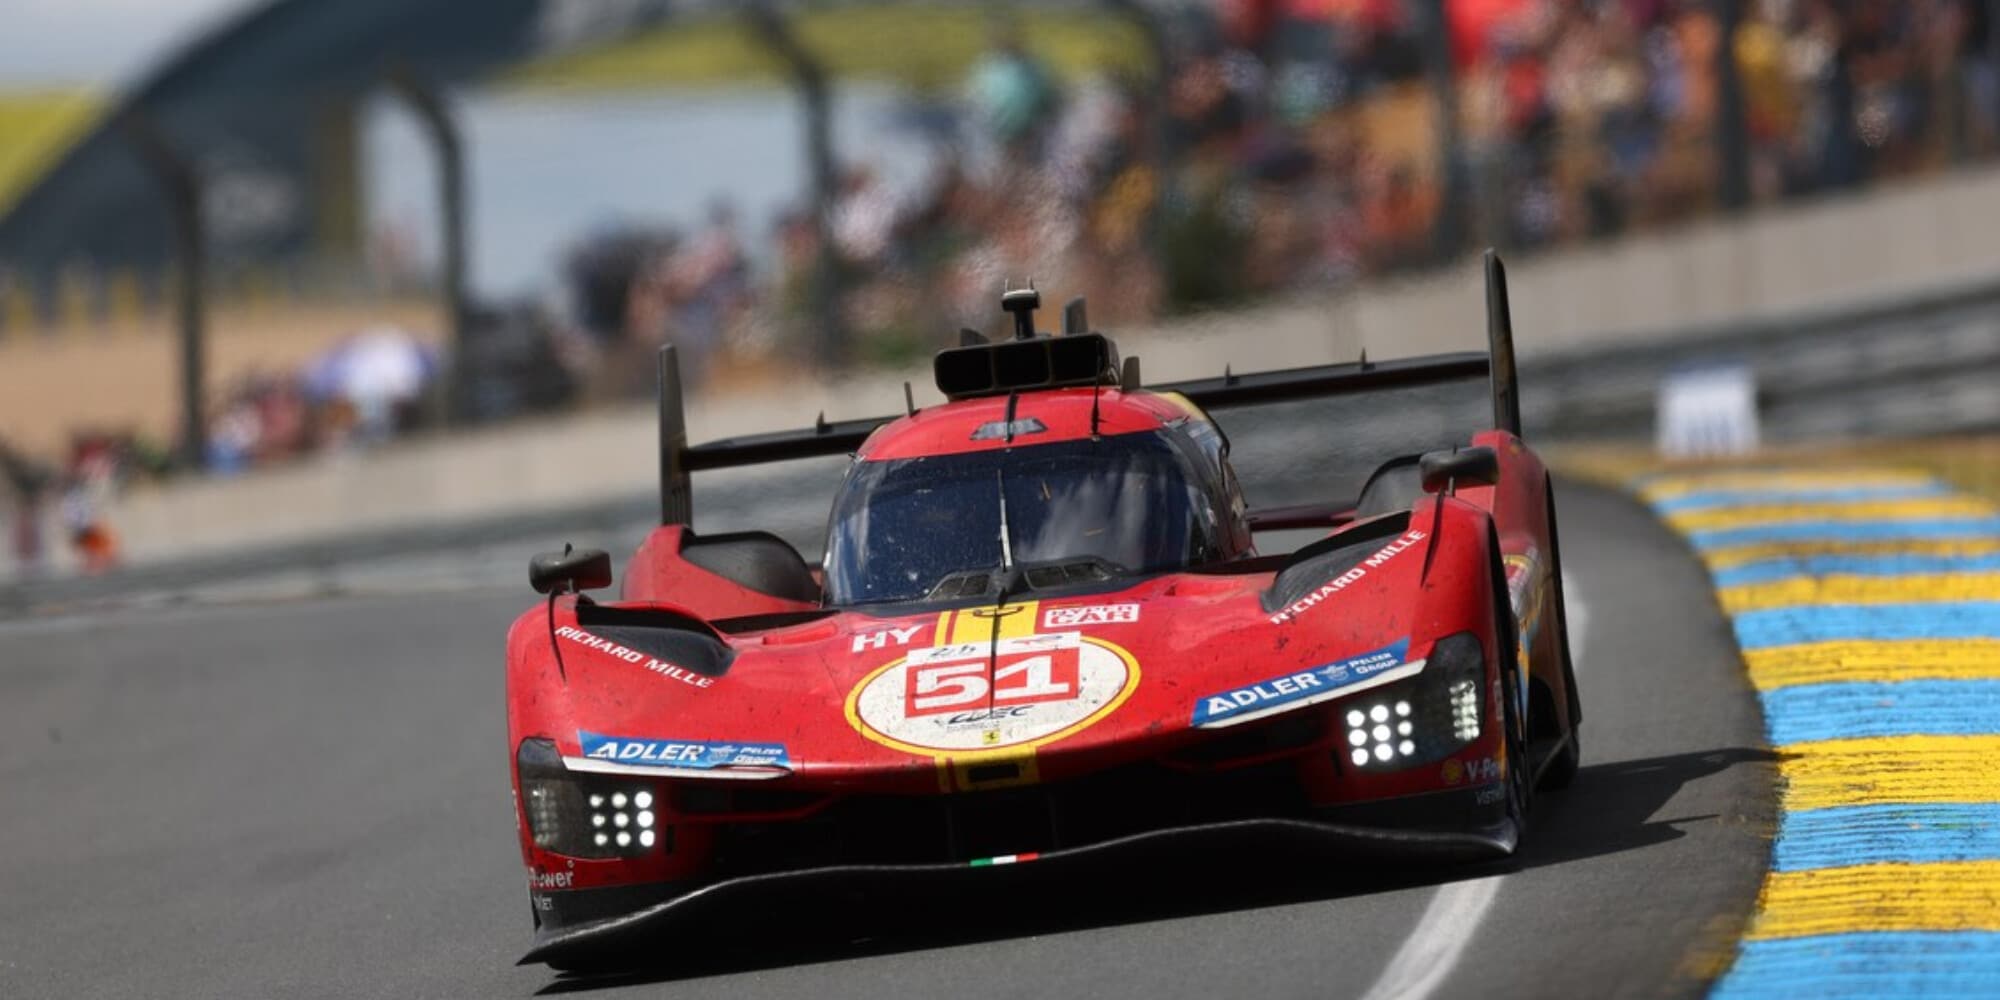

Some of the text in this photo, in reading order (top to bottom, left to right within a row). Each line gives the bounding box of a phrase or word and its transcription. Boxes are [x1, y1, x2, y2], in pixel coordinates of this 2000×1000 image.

[1364, 530, 1428, 568] MILLE
[1051, 611, 1133, 625] CAR
[852, 625, 923, 653] HY
[554, 625, 715, 688] RICHARD MILLE
[1347, 652, 1393, 669] PELZER
[1355, 659, 1399, 675] GROUP
[914, 654, 1071, 710] 51
[1207, 671, 1323, 717] ADLER
[948, 704, 1035, 725] WEC
[586, 741, 706, 762] ADLER
